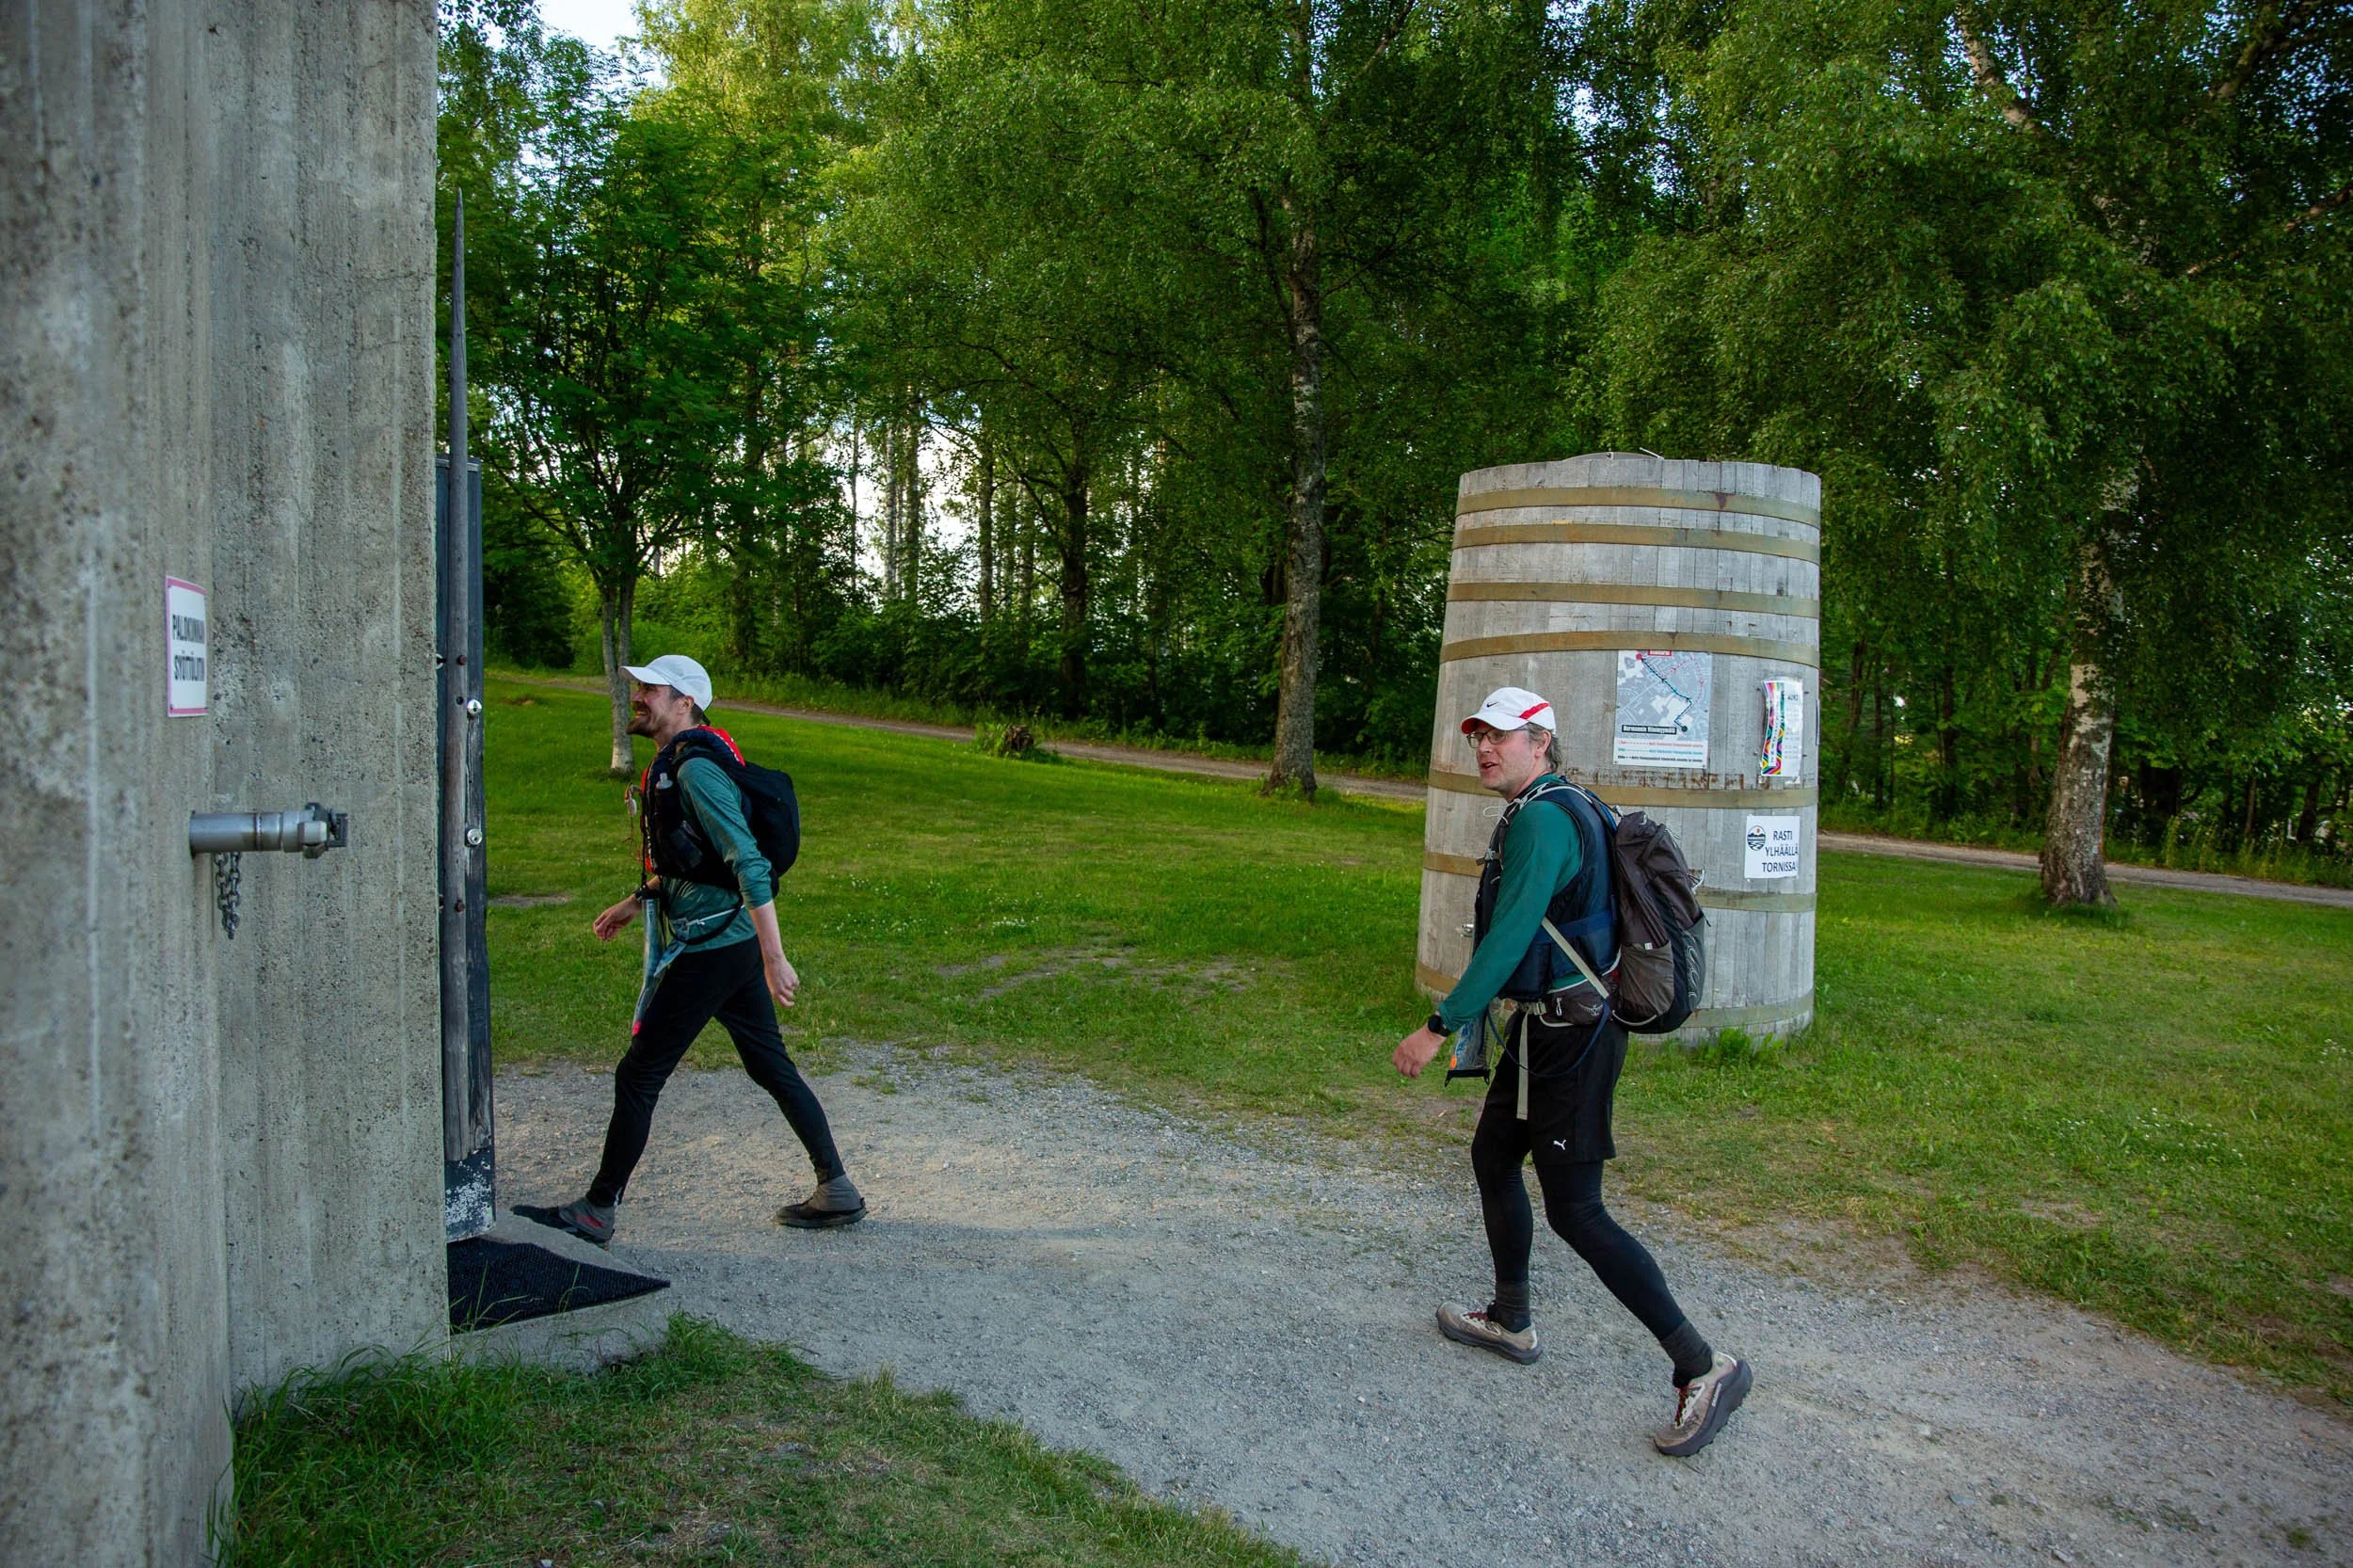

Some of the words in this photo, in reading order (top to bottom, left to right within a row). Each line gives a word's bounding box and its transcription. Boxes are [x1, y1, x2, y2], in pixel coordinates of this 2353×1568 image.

[1773, 830, 1793, 840] RASTI
[1765, 843, 1799, 856] YLHÄÄLLÄ
[1762, 861, 1796, 872] TORNISSA
